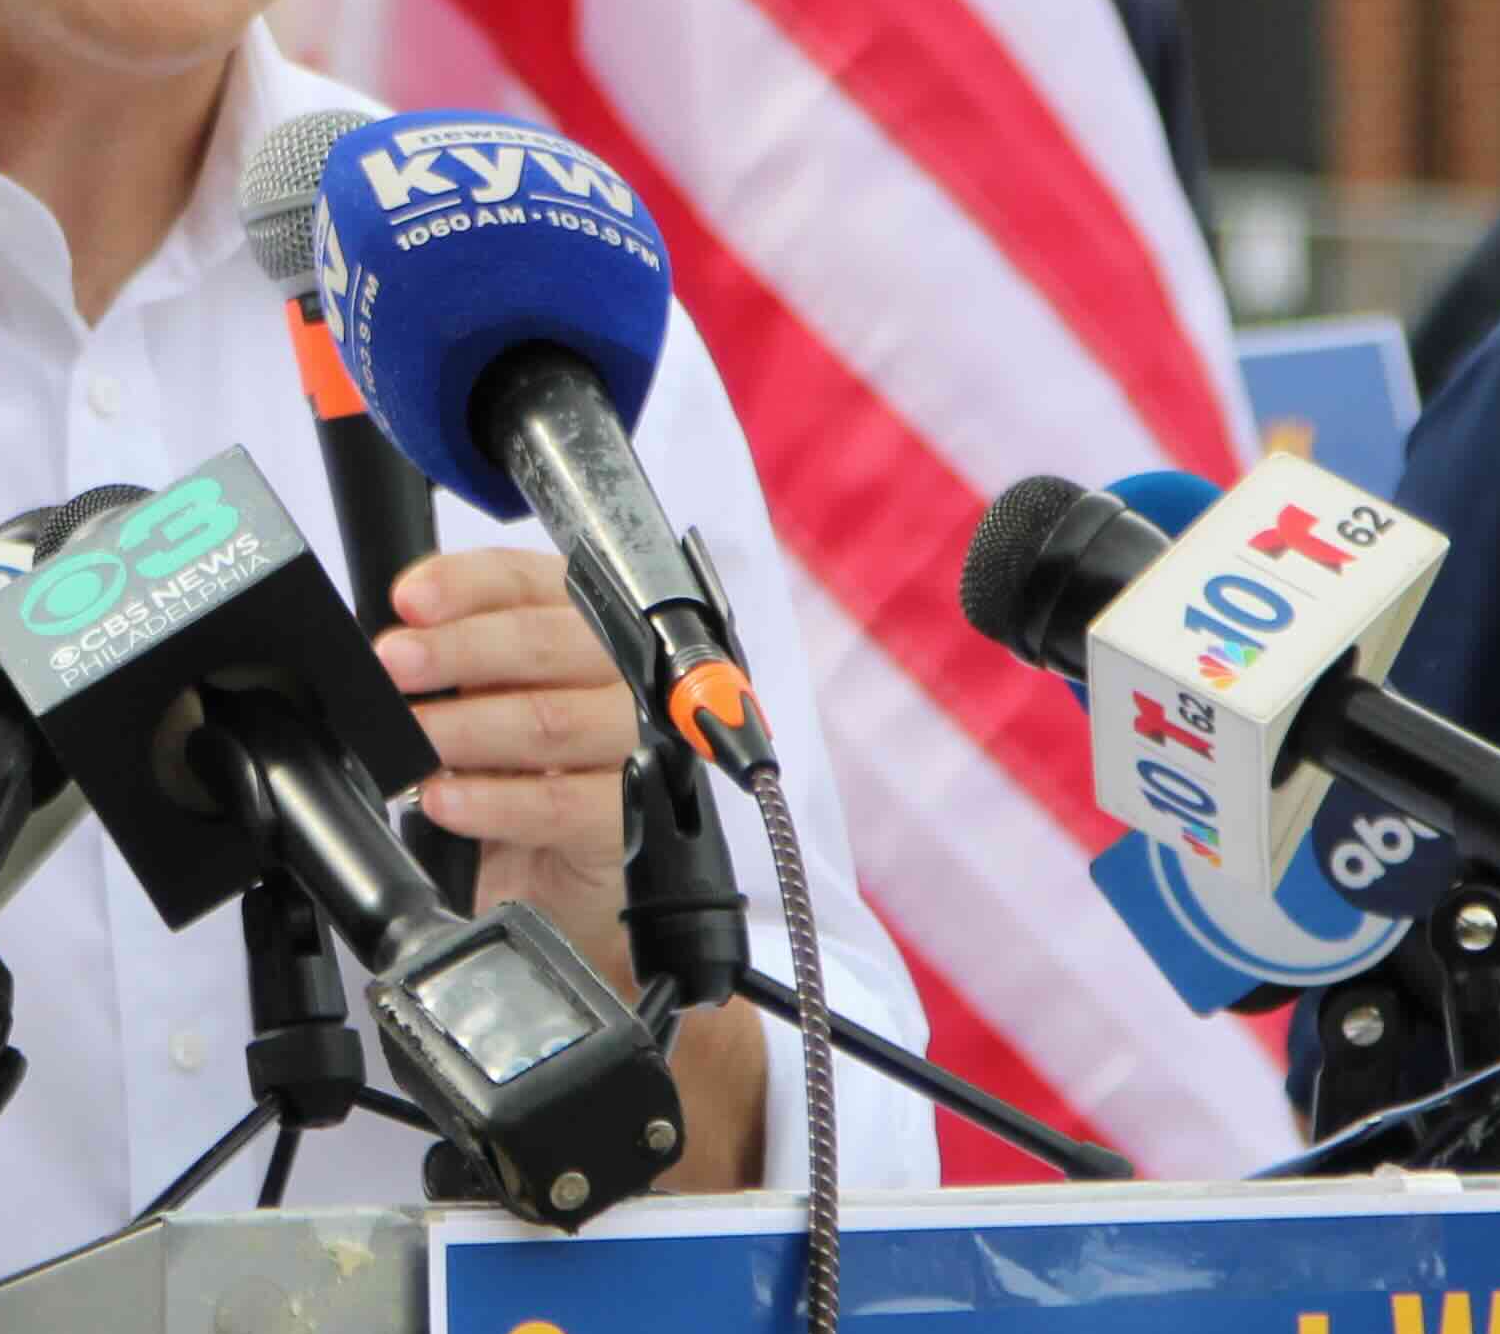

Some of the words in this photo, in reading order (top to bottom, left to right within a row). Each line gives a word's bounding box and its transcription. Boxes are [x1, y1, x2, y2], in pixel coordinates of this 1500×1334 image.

[396, 213, 472, 251] 1060
[477, 208, 527, 227] AM
[623, 235, 661, 273] FM
[60, 554, 270, 688] PHILADELPHIA
[80, 601, 150, 651] CBS
[151, 533, 260, 608] NEWS
[1185, 574, 1294, 652] 10
[1337, 506, 1395, 547] 62
[1178, 693, 1214, 735] 62
[1330, 816, 1440, 890] ab
